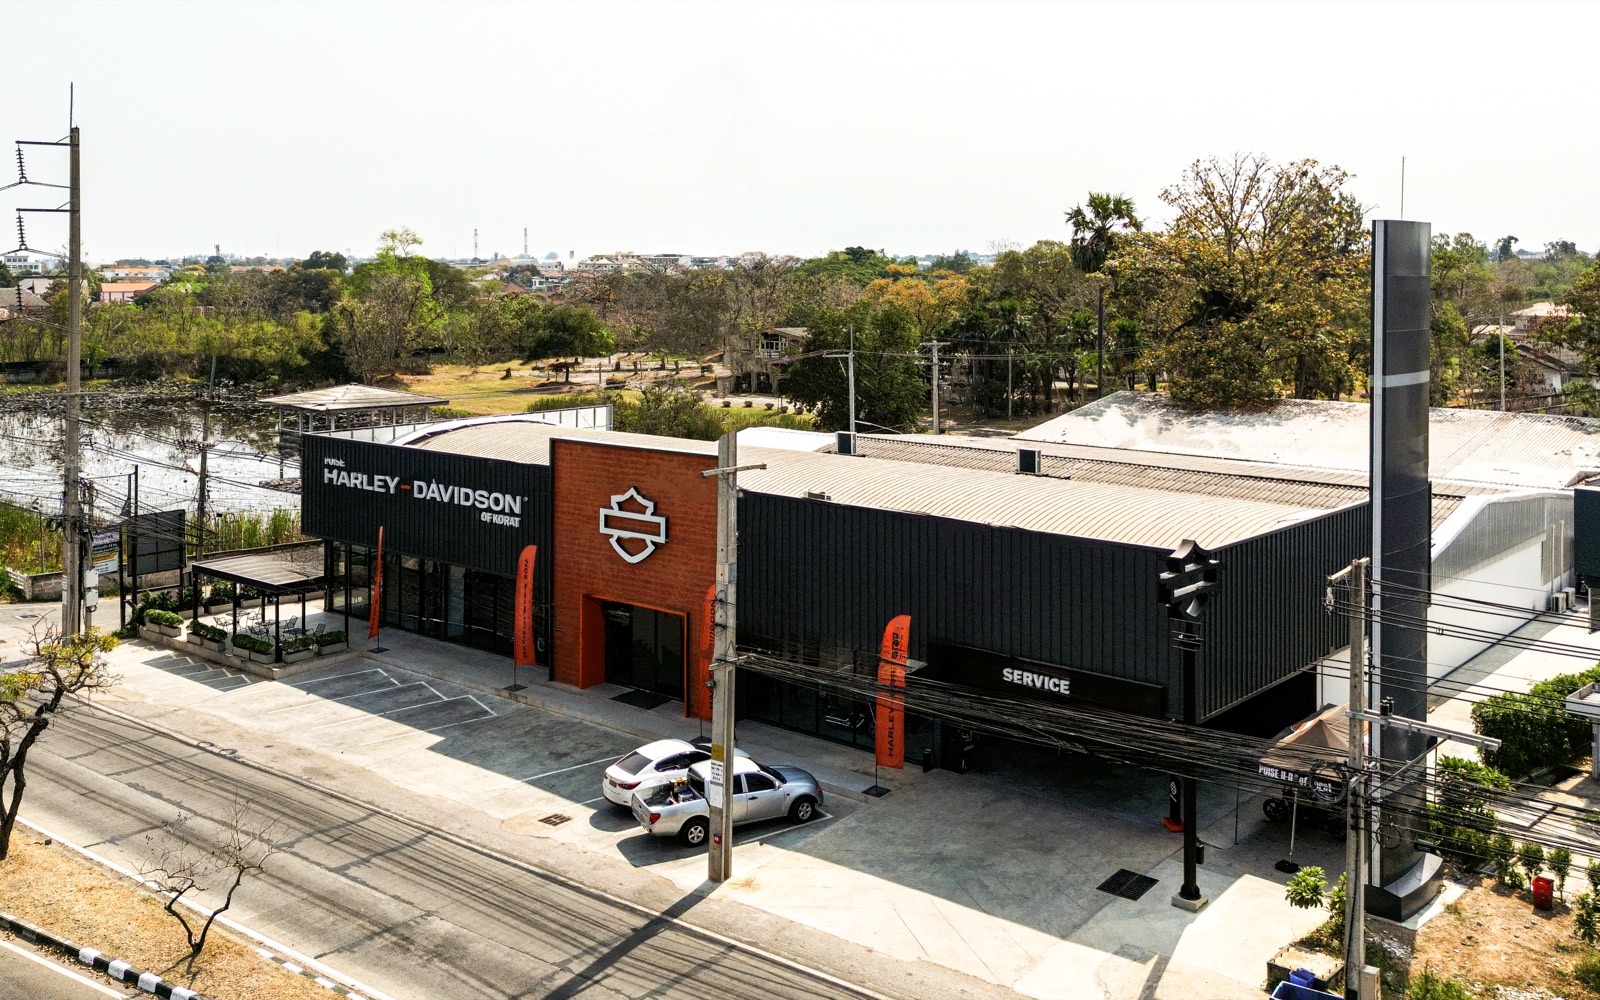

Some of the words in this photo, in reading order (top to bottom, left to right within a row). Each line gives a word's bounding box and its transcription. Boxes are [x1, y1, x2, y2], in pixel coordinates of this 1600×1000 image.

[480, 511, 493, 523] OF
[492, 513, 521, 528] KORAT
[1002, 667, 1071, 695] SERVICE
[1258, 763, 1280, 778] POISE
[1298, 776, 1308, 787] of
